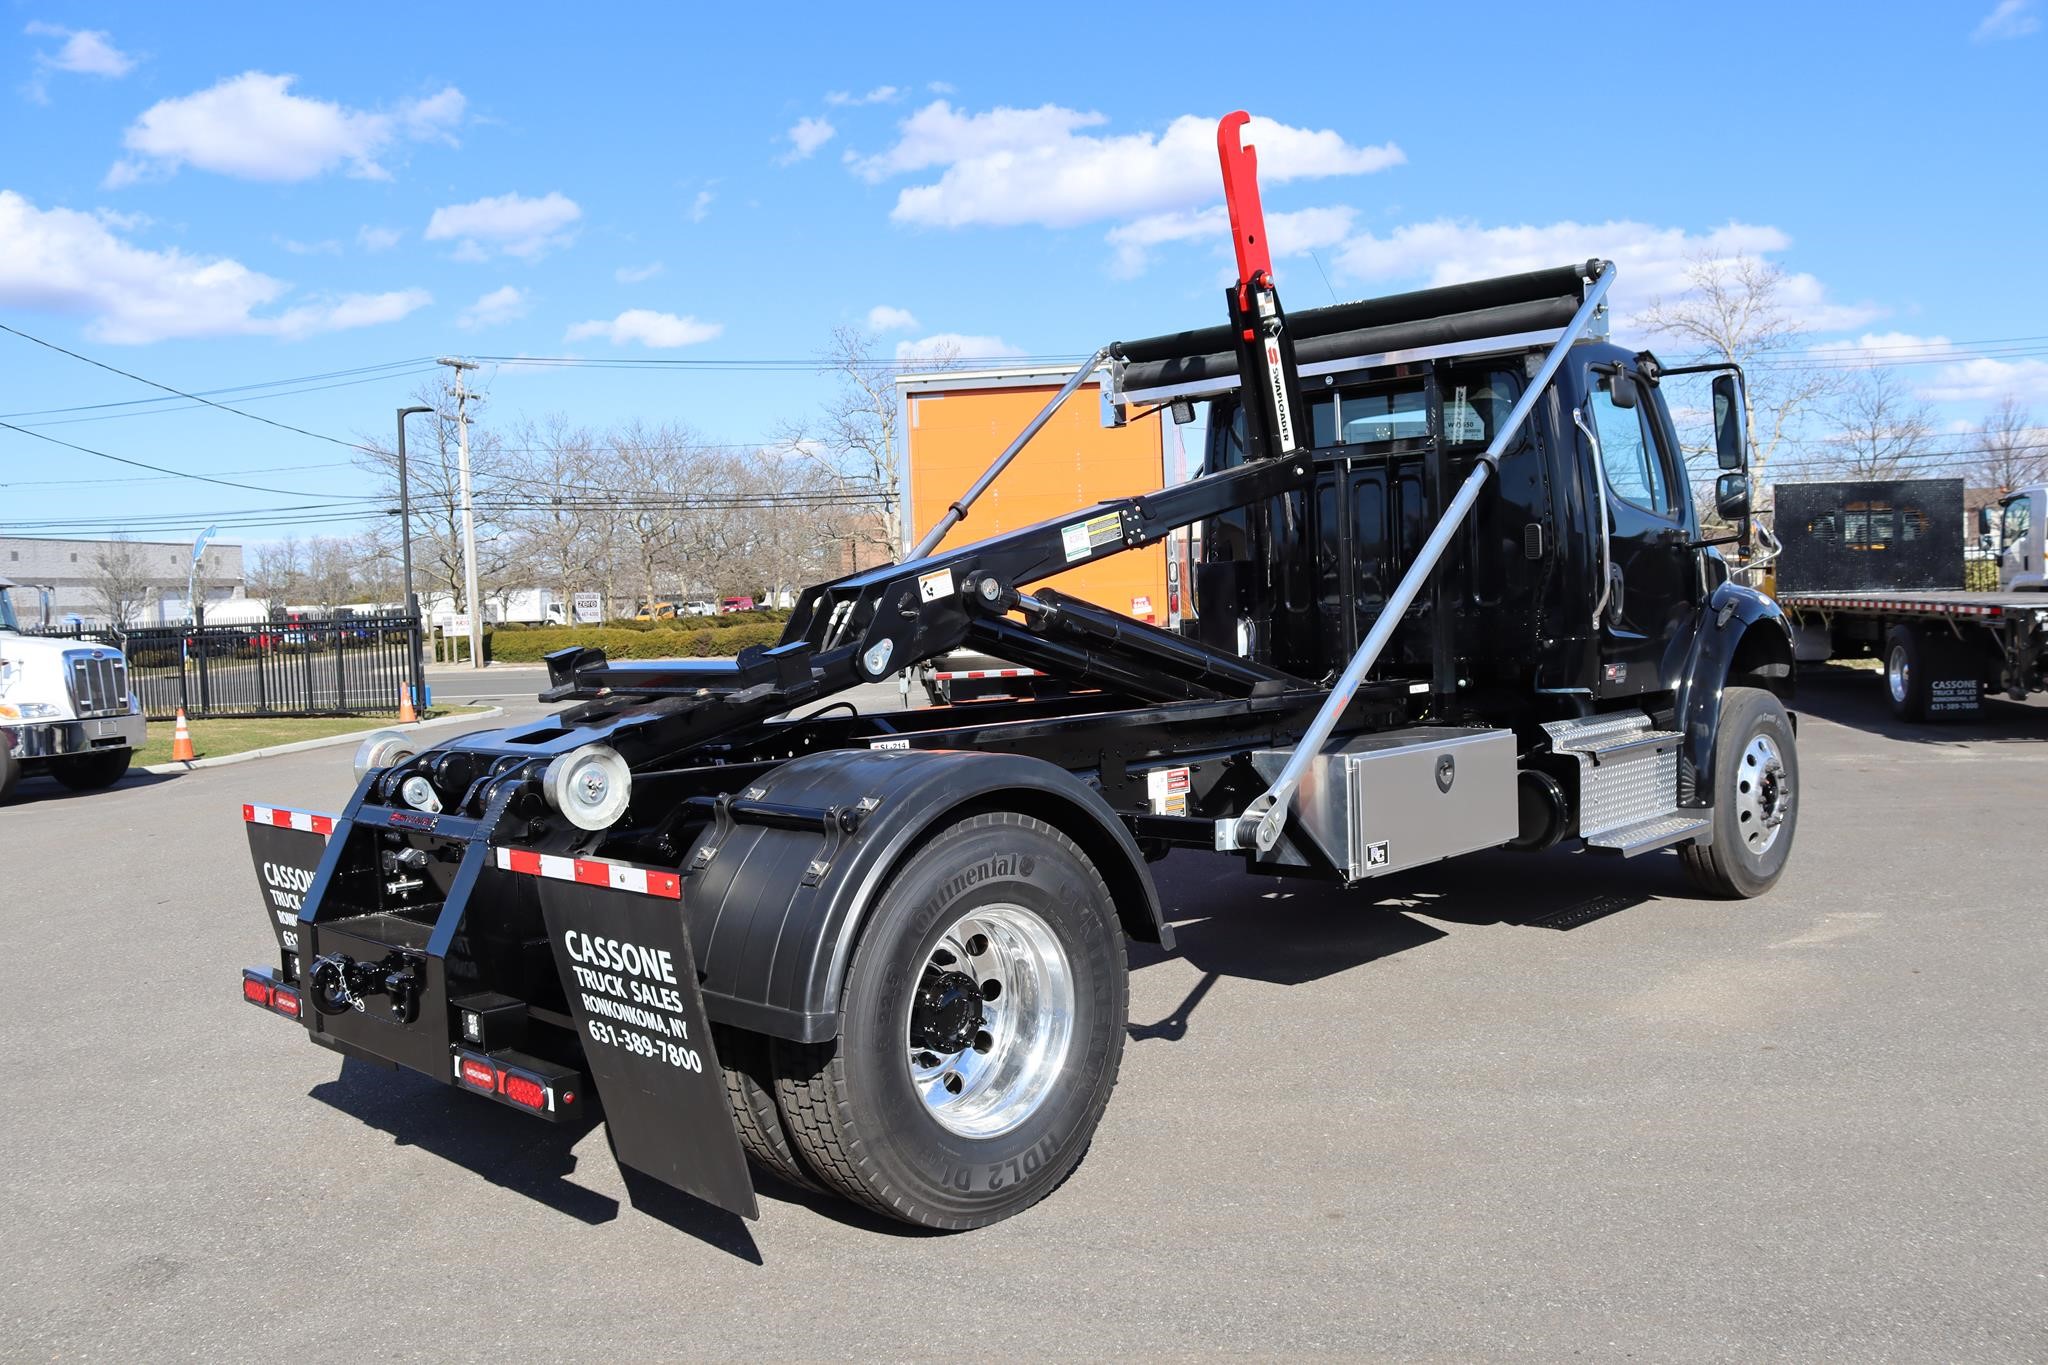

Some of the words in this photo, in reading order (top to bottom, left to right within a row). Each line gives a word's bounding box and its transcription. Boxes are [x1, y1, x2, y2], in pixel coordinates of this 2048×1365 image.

[1272, 368, 1290, 441] SWAPLOADER
[1932, 681, 1976, 689] CASSONE
[263, 862, 316, 893] CASSON
[269, 888, 301, 910] TRUCK
[908, 852, 1018, 935] Continental
[565, 930, 677, 985] CASSONE
[572, 965, 628, 999] TRUCK
[630, 980, 683, 1013] SALES
[581, 992, 671, 1038] RONKONKOMA,
[668, 1017, 688, 1040] NY
[588, 1020, 702, 1074] 631-389-7800
